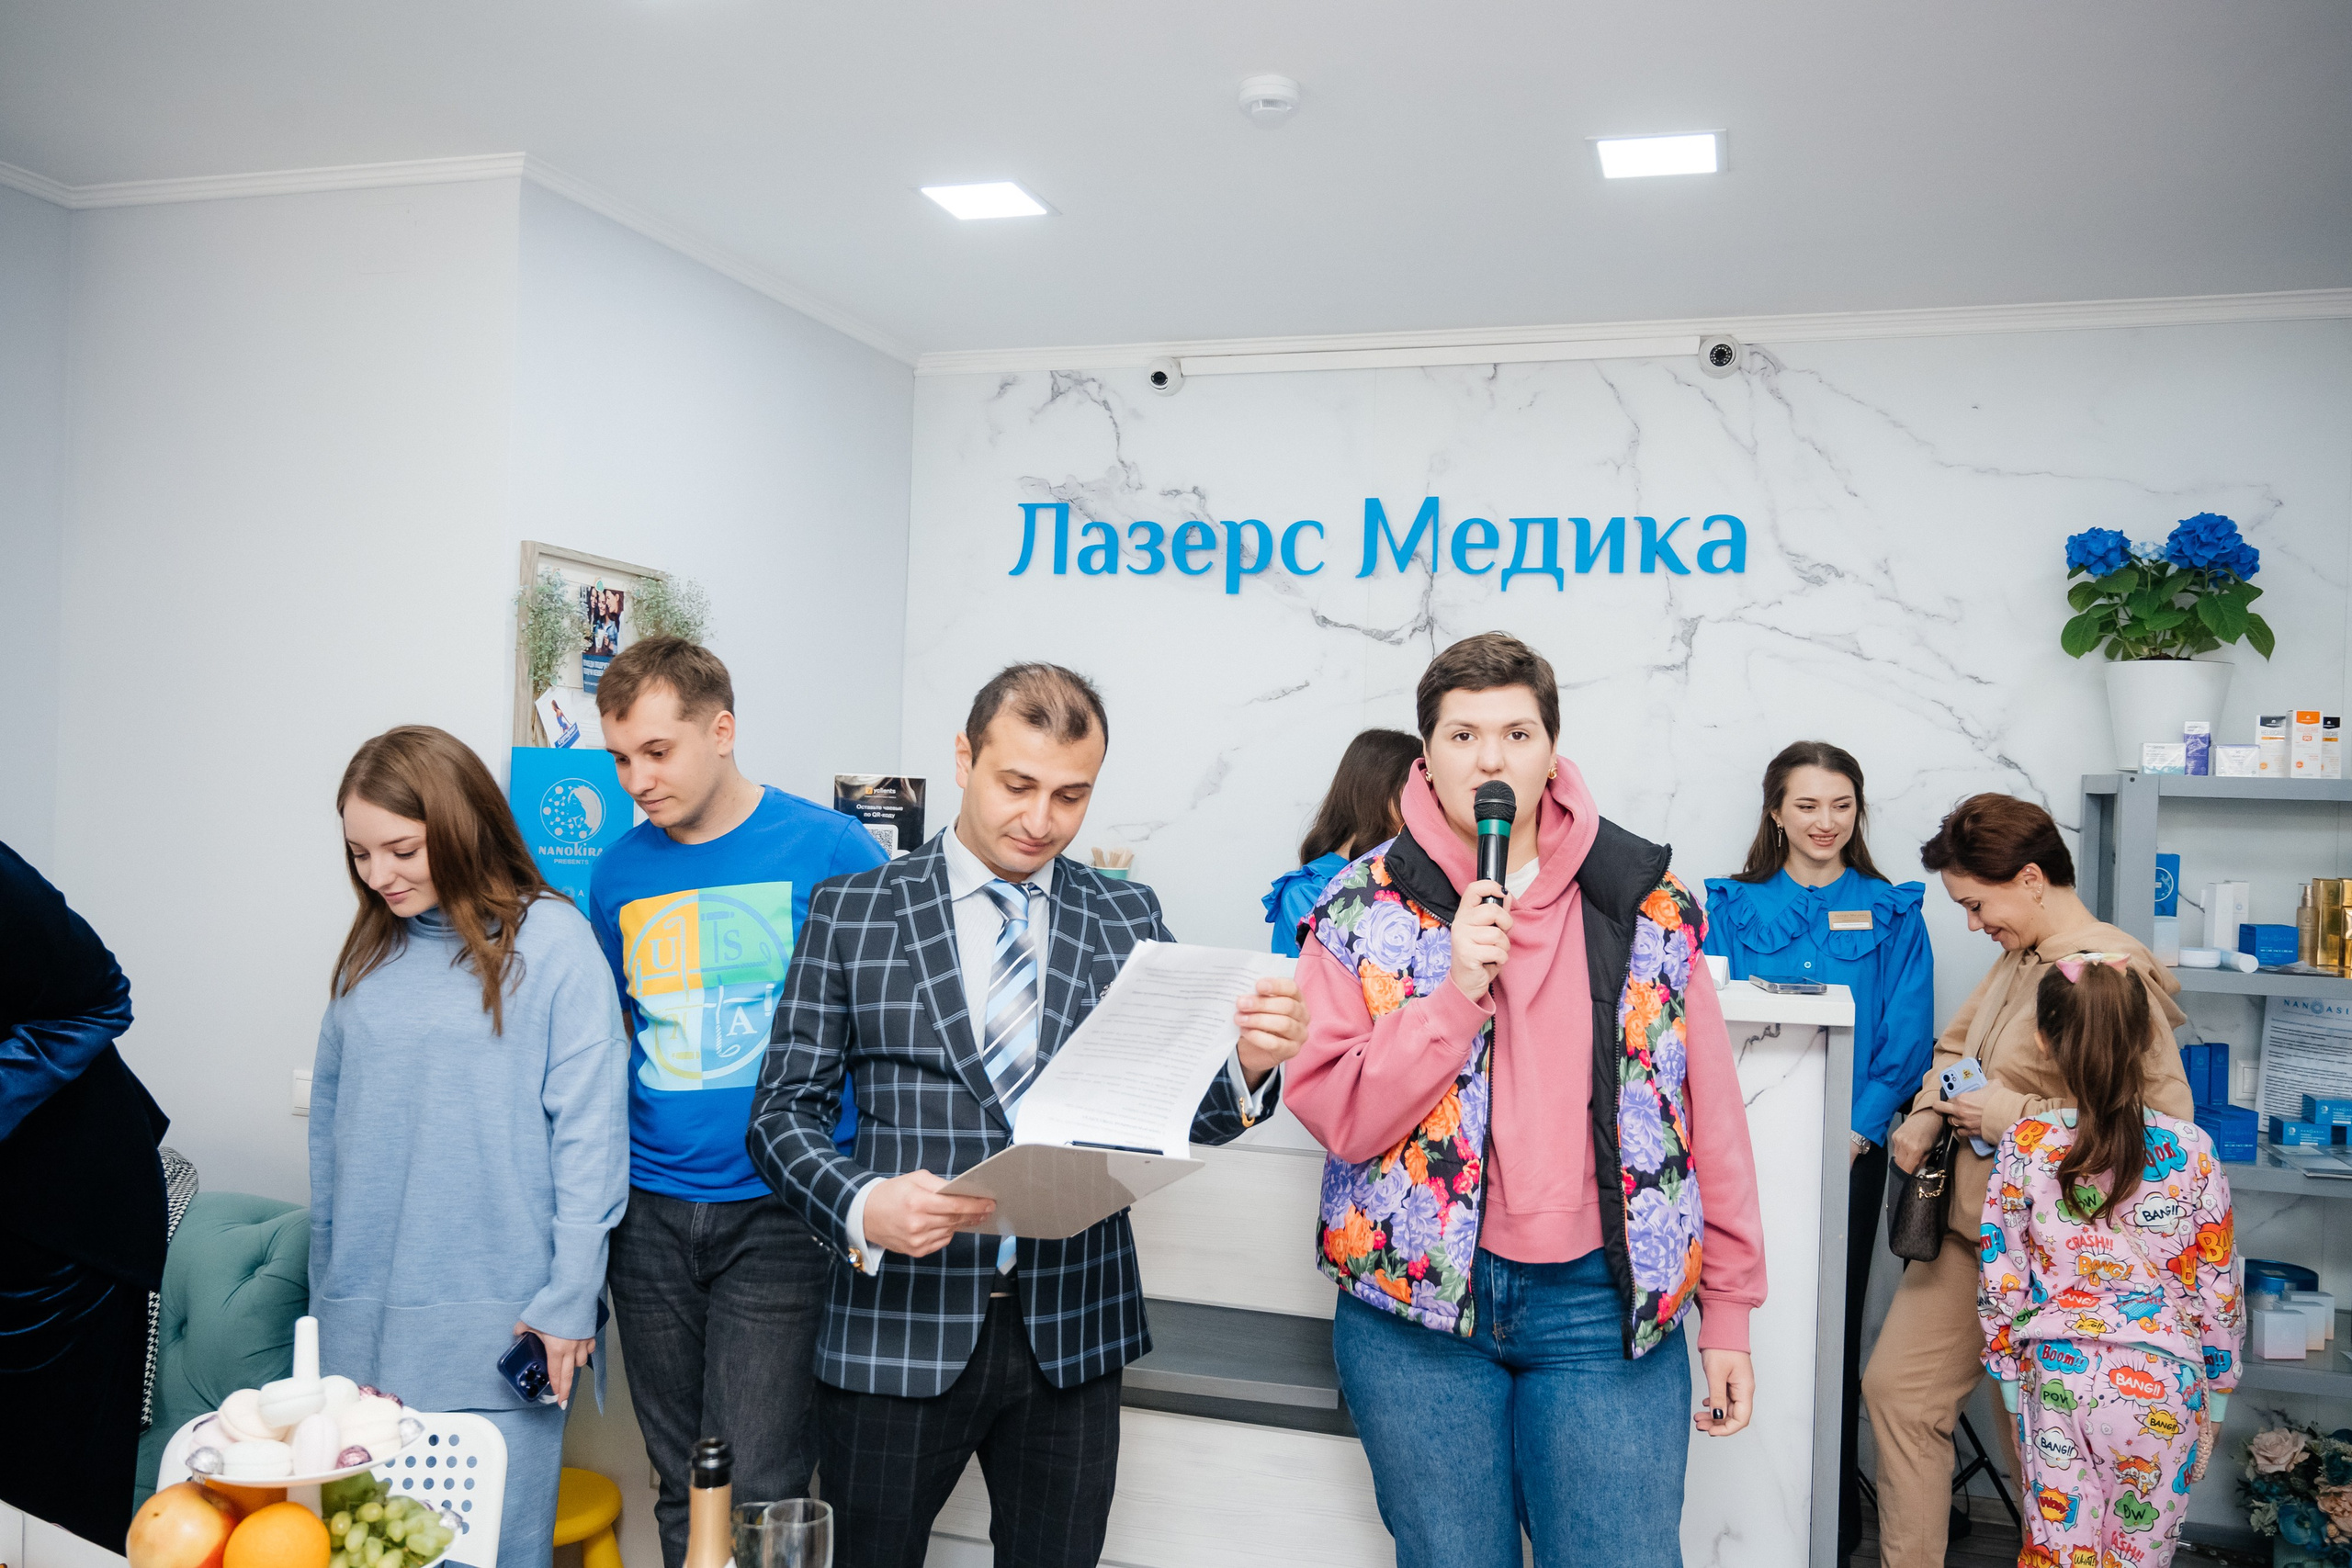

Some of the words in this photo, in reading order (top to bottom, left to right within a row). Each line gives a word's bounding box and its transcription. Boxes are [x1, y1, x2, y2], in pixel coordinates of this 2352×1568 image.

[1008, 502, 1325, 594] Лазерс
[1355, 496, 1747, 592] Медика
[871, 811, 896, 819] QR-коду
[723, 929, 743, 961] S
[726, 1006, 758, 1036] A
[2065, 1235, 2113, 1250] CRASH!!
[2078, 1255, 2134, 1280] BANG!
[2116, 1372, 2161, 1396] BANG!!
[2150, 1417, 2177, 1432] BANG!!
[2041, 1438, 2074, 1457] BANG!!
